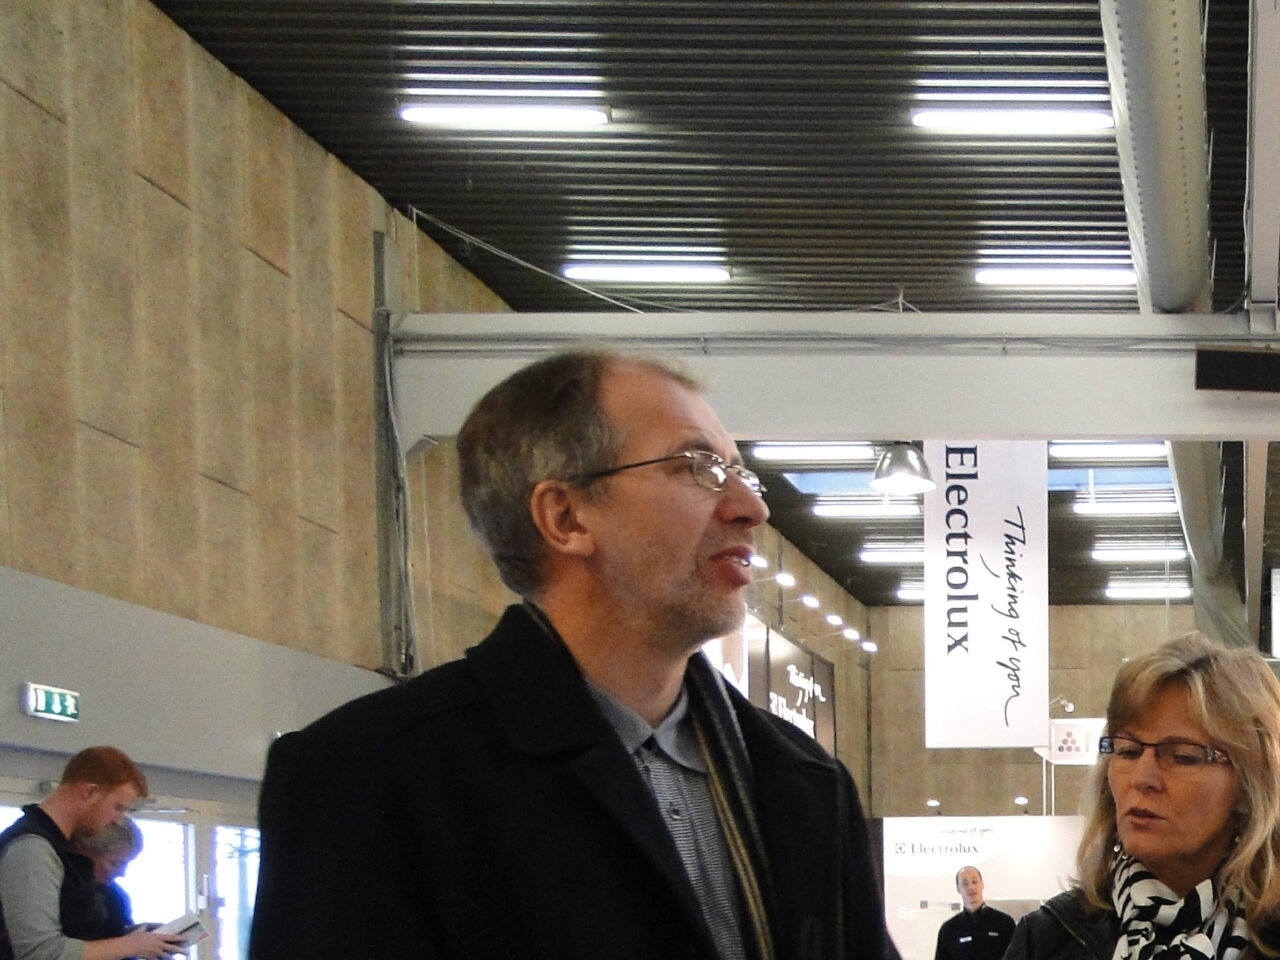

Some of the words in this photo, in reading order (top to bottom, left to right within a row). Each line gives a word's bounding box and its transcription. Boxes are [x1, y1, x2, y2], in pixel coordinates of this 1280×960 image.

[945, 445, 979, 655] Electrolux
[979, 505, 1026, 620] Thinking
[1001, 628, 1027, 652] of
[995, 657, 1021, 727] you
[911, 843, 979, 854] Electrolux
